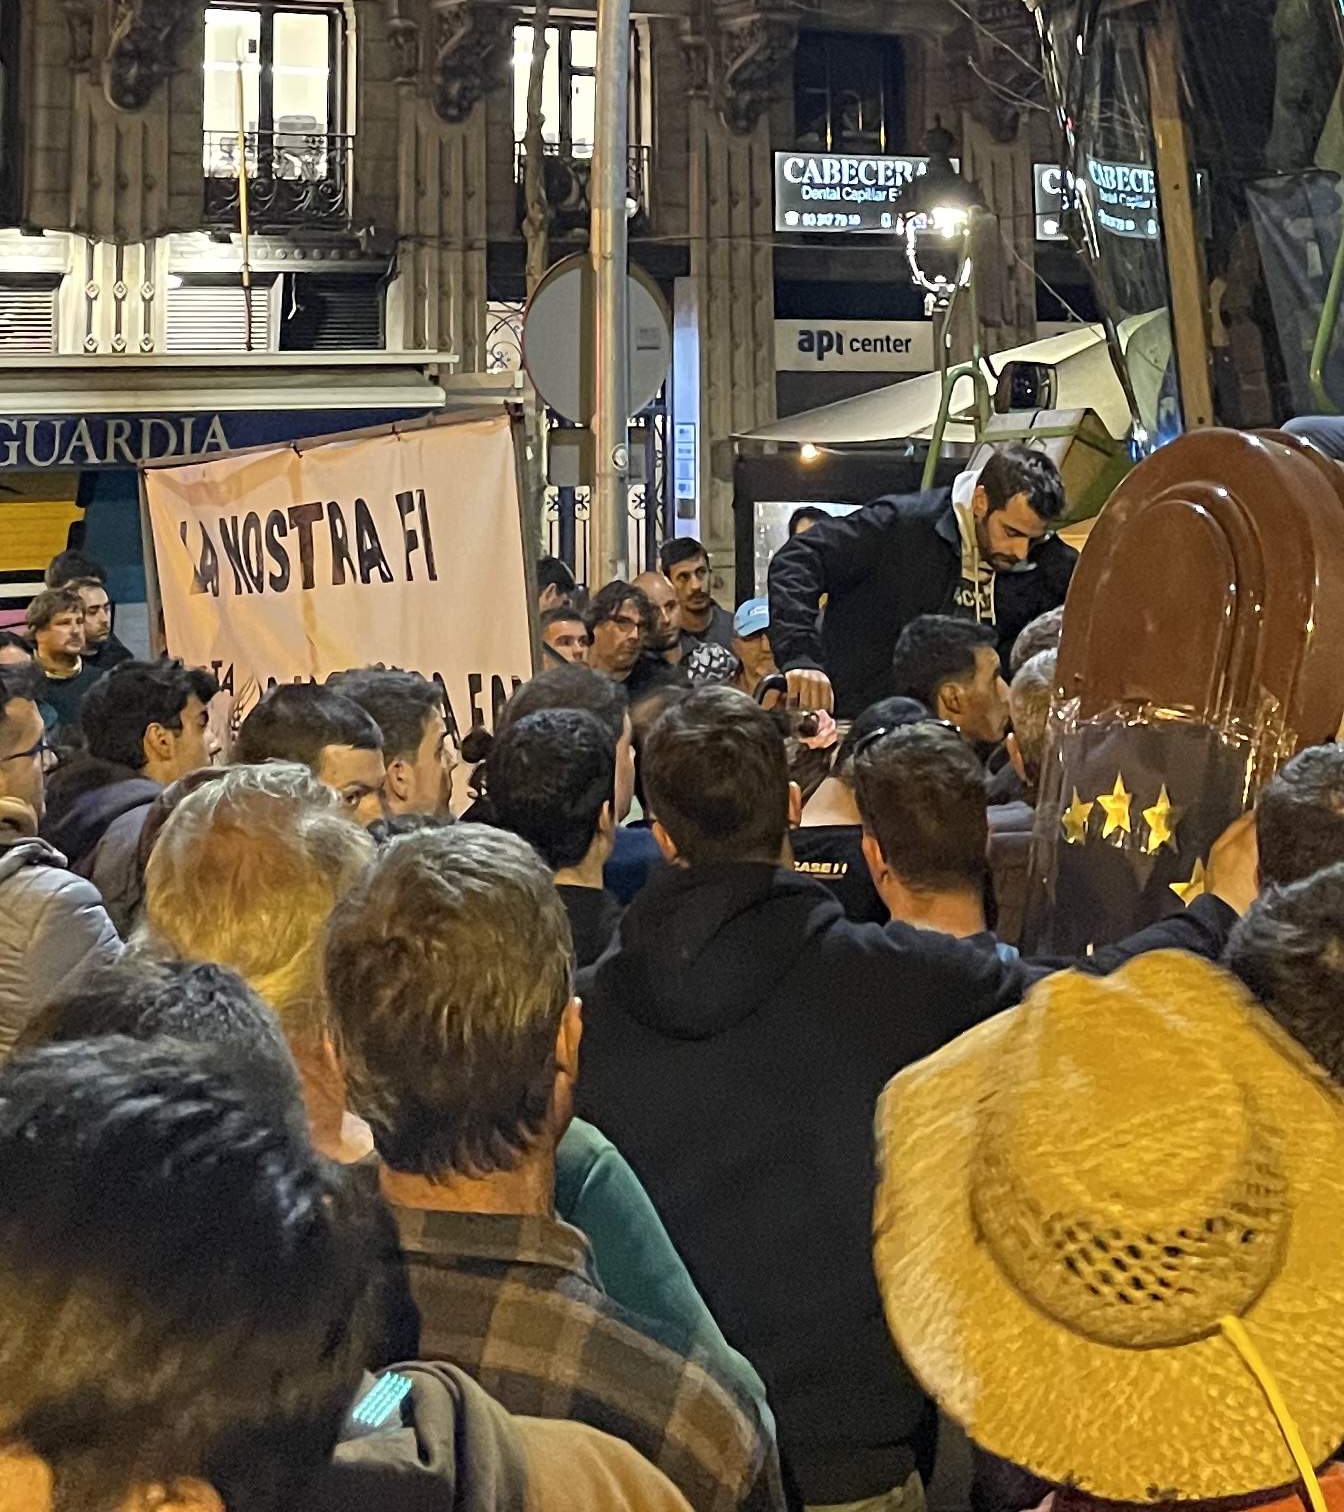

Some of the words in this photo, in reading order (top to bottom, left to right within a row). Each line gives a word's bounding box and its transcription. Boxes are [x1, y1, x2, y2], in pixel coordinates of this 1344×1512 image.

[801, 186, 840, 201] Dental
[842, 186, 887, 203] Capillar
[850, 335, 912, 353] center
[219, 498, 394, 595] NOSTRA
[395, 489, 438, 581] FI
